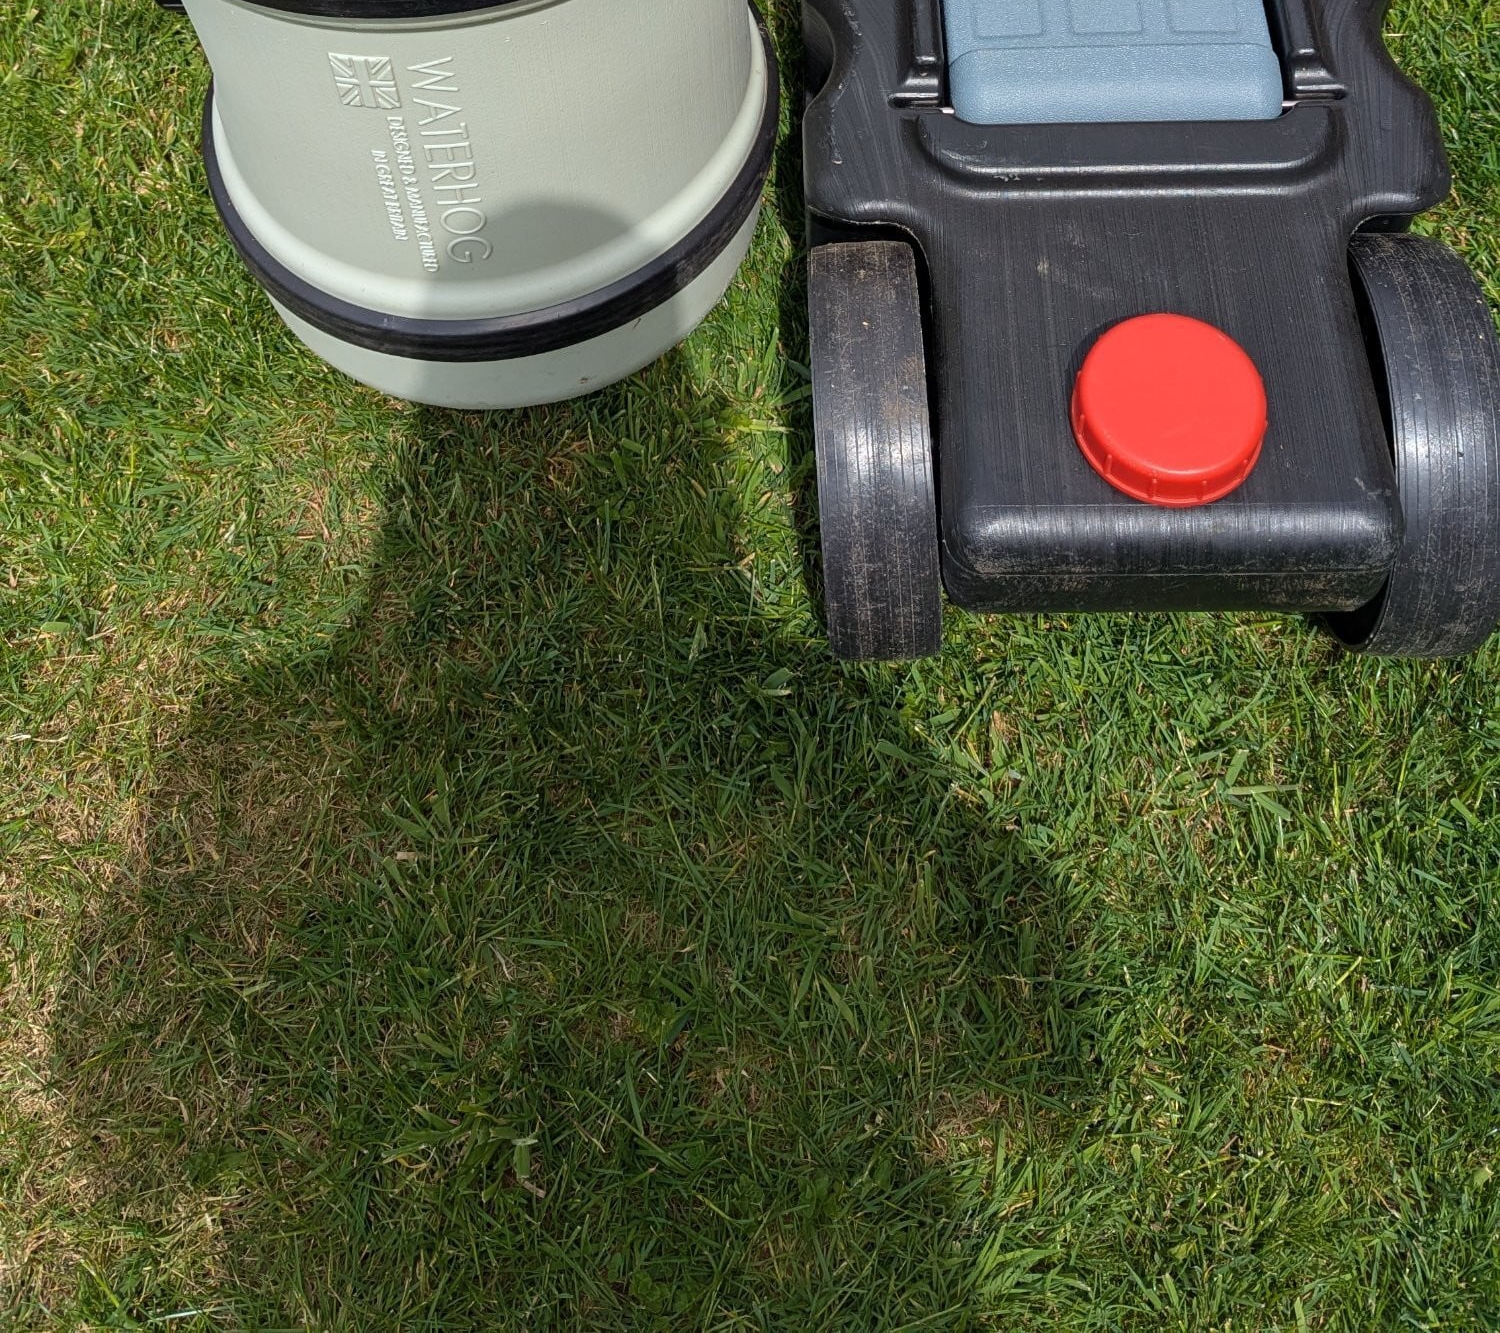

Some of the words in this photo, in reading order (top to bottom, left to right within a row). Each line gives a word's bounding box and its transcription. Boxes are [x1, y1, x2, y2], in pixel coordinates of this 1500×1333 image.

[371, 149, 389, 164] IN
[406, 56, 493, 264] WATERHOG
[375, 164, 398, 201] GREAT
[386, 116, 416, 178] DESIGNED
[404, 187, 440, 273] MANUFACTURED
[383, 201, 408, 241] BRITAIN
